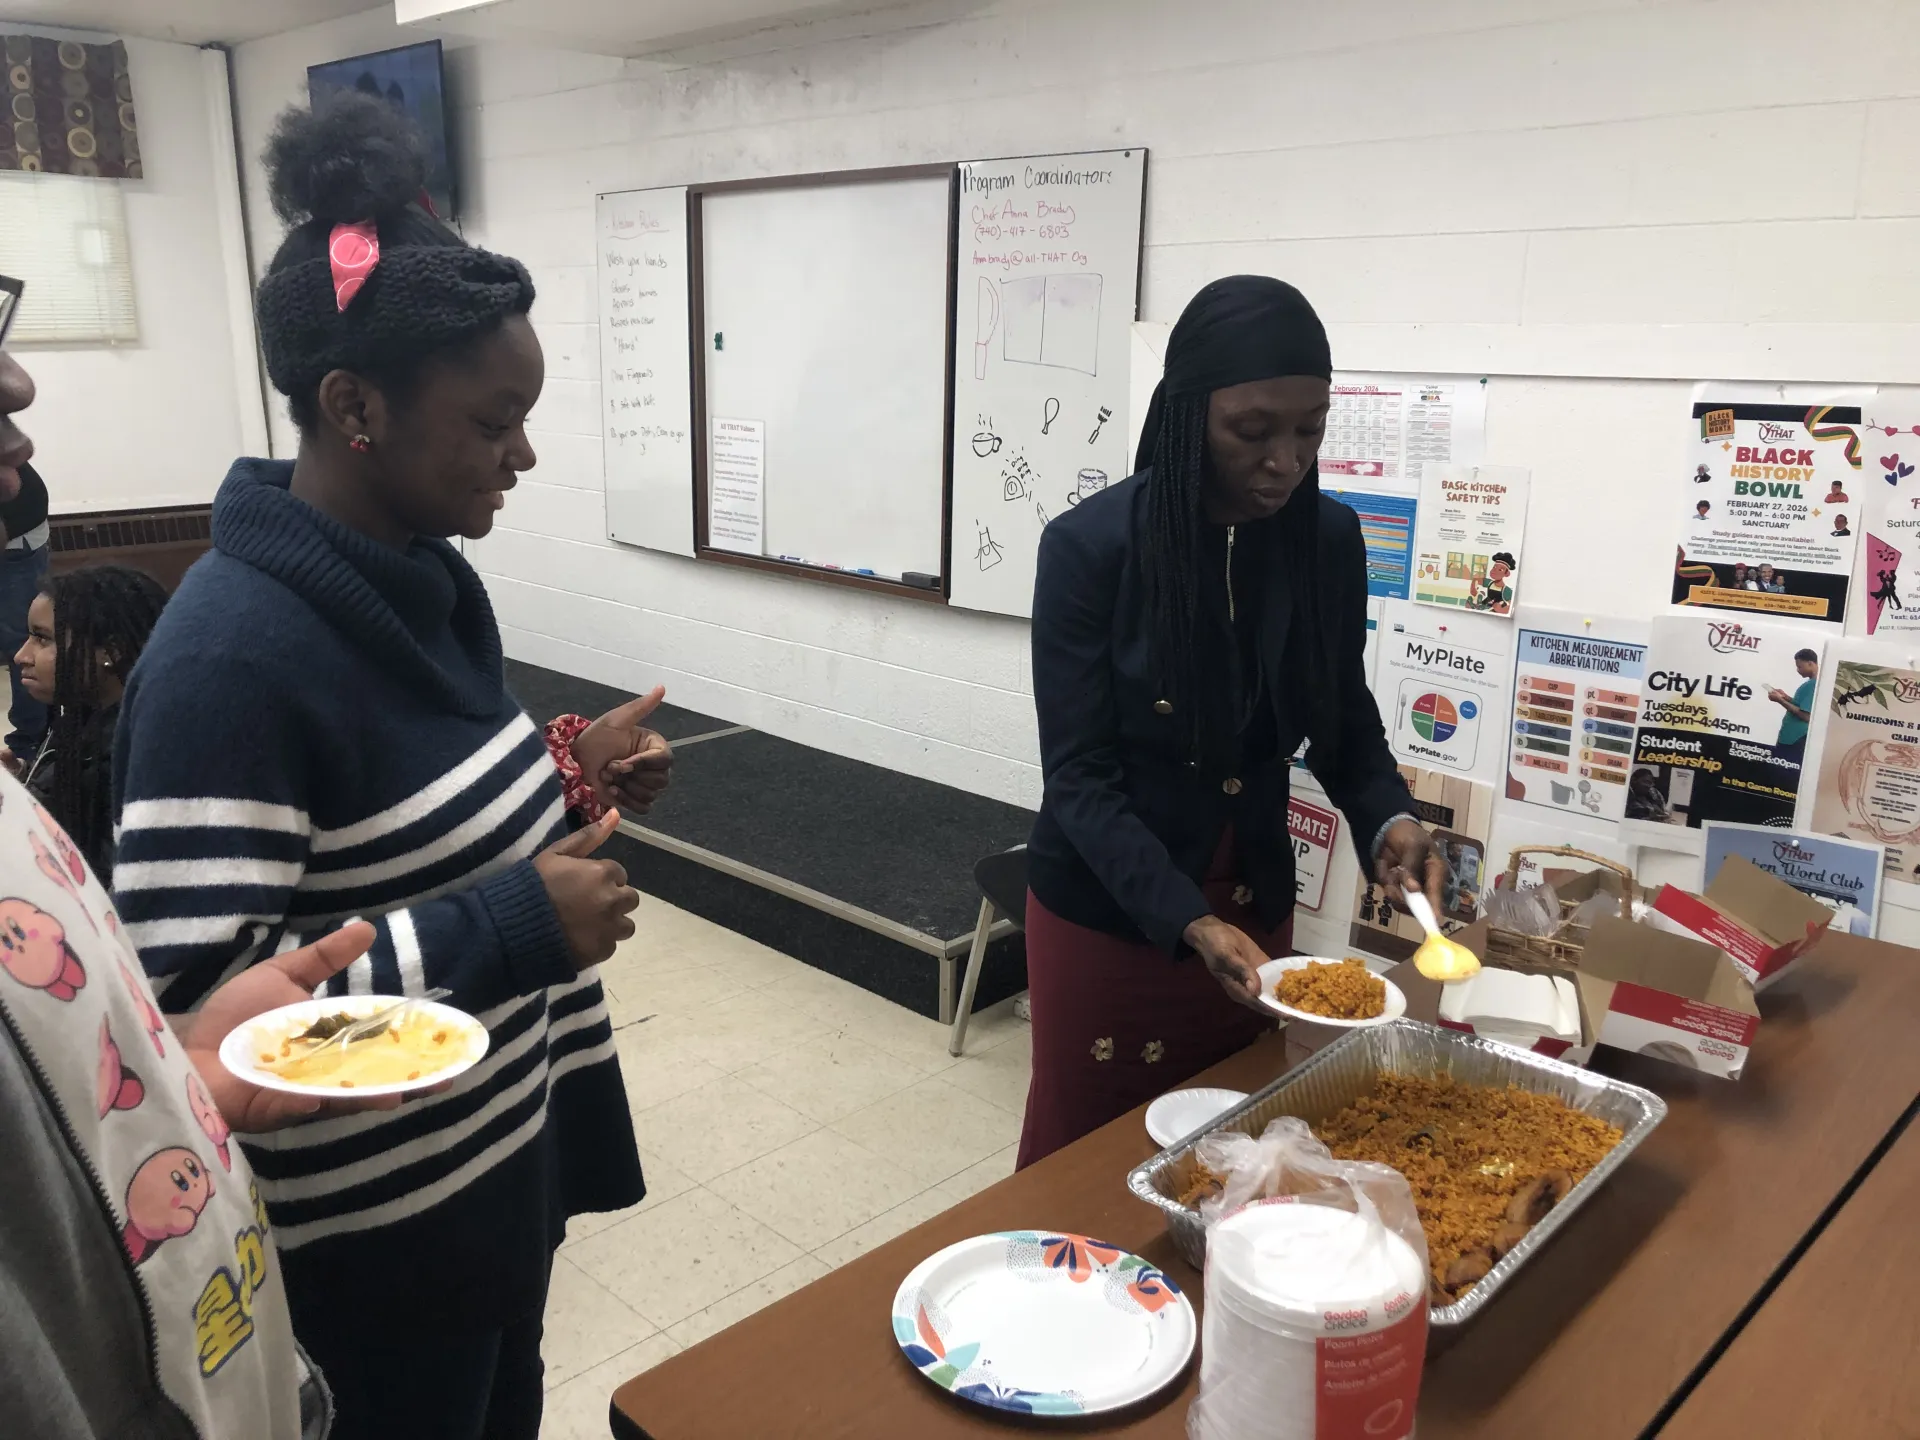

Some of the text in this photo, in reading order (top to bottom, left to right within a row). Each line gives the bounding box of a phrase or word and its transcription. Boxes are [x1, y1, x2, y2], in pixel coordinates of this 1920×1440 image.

[963, 164, 1015, 199] Program
[1002, 199, 1029, 219] Anna
[1036, 200, 1076, 224] Brady
[606, 250, 625, 267] Wash
[644, 250, 667, 268] hands
[1709, 412, 1730, 421] BLACK
[1770, 429, 1795, 438] THAT
[1735, 447, 1815, 466] BLACK
[1730, 464, 1816, 482] HISTORY
[1446, 492, 1480, 504] SAFETY
[1734, 481, 1803, 500] BOWL
[1726, 500, 1808, 512] FEBRUARY 27, 2026
[1729, 509, 1748, 517] 5:00
[1742, 519, 1790, 529] SANCTUARY
[1530, 635, 1644, 663] KITCHEN MEASUREMENT
[1726, 633, 1762, 649] THAT
[1406, 642, 1485, 674] MyPlate
[1549, 651, 1620, 674] ABBREVIATIONS
[1648, 670, 1753, 700] City Life
[1615, 695, 1628, 703] PINT
[1644, 700, 1708, 715] Tuesdays
[1408, 743, 1458, 762] MyPlate.gov
[1639, 734, 1702, 753] Student
[1729, 740, 1772, 756] Tuesdays
[1637, 749, 1723, 773] Leadership
[1732, 777, 1746, 788] the
[1747, 782, 1772, 794] Game
[1773, 787, 1798, 799] Room
[1787, 850, 1815, 862] THAT
[1781, 862, 1826, 883] Word
[1830, 873, 1864, 891] Club
[1701, 928, 1731, 949] Spoons
[1731, 945, 1756, 966] Plastic
[1672, 1016, 1743, 1042] Plastic Spoons
[1698, 1045, 1735, 1060] Gordon
[1324, 1309, 1368, 1320] Gordon
